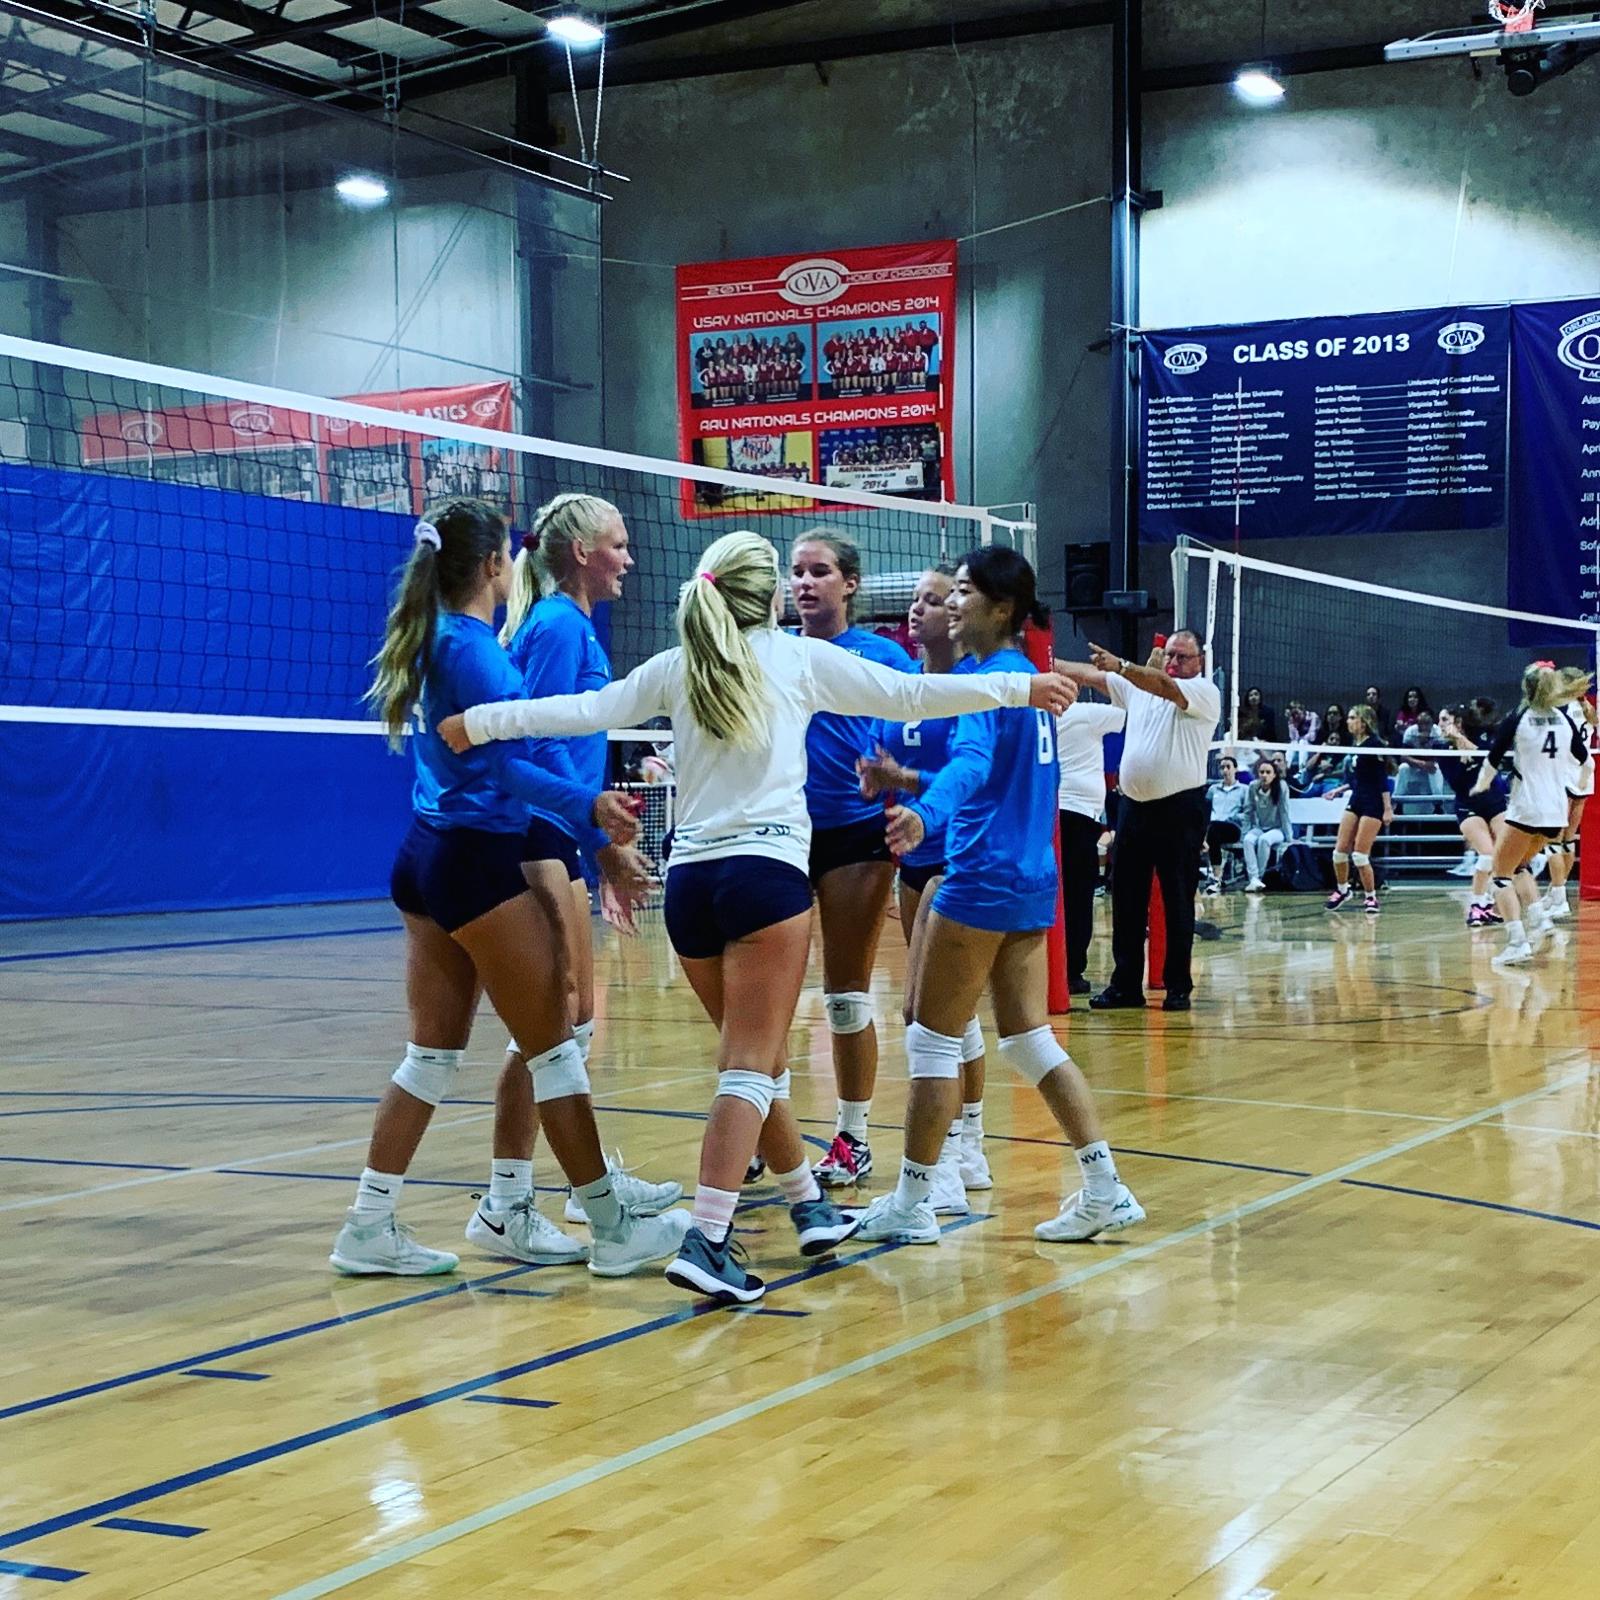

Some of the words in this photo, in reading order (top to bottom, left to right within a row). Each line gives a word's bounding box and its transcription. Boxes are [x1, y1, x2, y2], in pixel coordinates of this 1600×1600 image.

[794, 272, 830, 292] OVA
[876, 270, 890, 280] OF
[707, 284, 753, 296] 2014
[694, 316, 731, 329] USAV
[734, 307, 814, 326] NATIONALS
[816, 300, 901, 318] CHAMPIONS
[904, 296, 940, 310] 2014
[1446, 331, 1474, 346] OVA
[1234, 340, 1308, 364] CLASS
[1315, 338, 1347, 358] OF
[1352, 332, 1410, 355] 2013
[1171, 352, 1198, 366] OVA
[423, 404, 468, 420] ASICS
[700, 419, 729, 431] AAU
[732, 412, 811, 430] NATIONALS
[814, 406, 897, 424] CHAMPIONS
[900, 404, 936, 418] 2014
[862, 480, 888, 490] 2014
[1541, 731, 1558, 759] 4
[1081, 1150, 1107, 1165] NVL
[903, 1168, 929, 1182] NVL
